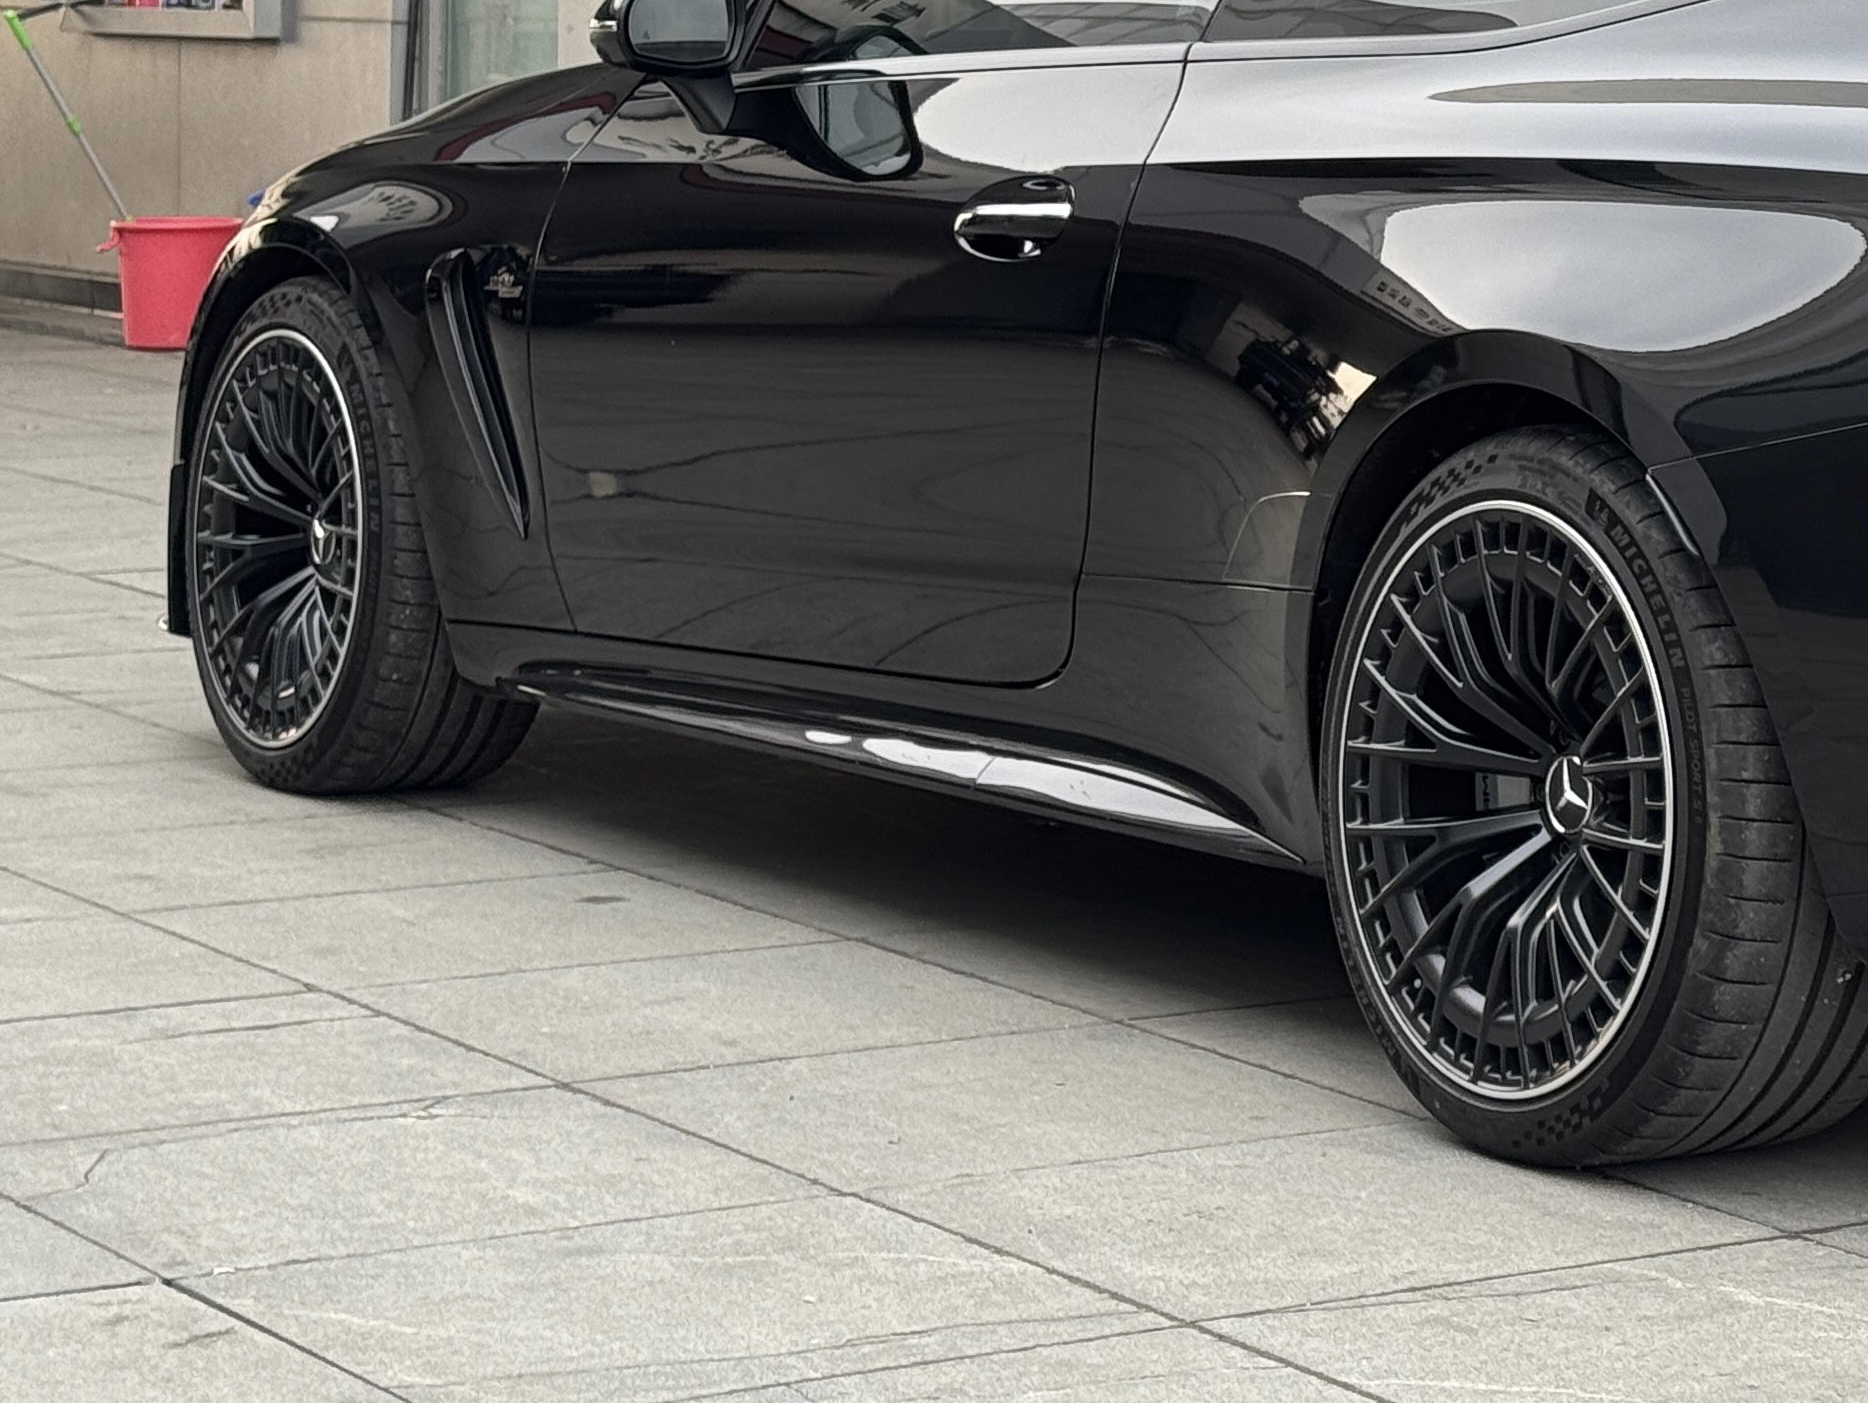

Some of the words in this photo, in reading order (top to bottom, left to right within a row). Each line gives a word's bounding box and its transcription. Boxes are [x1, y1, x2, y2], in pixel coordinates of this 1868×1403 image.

[349, 380, 382, 534] MICHELIN
[1608, 519, 1688, 669] MICHELIN
[1680, 686, 1698, 735] PILOT
[1688, 736, 1704, 795] SPORT
